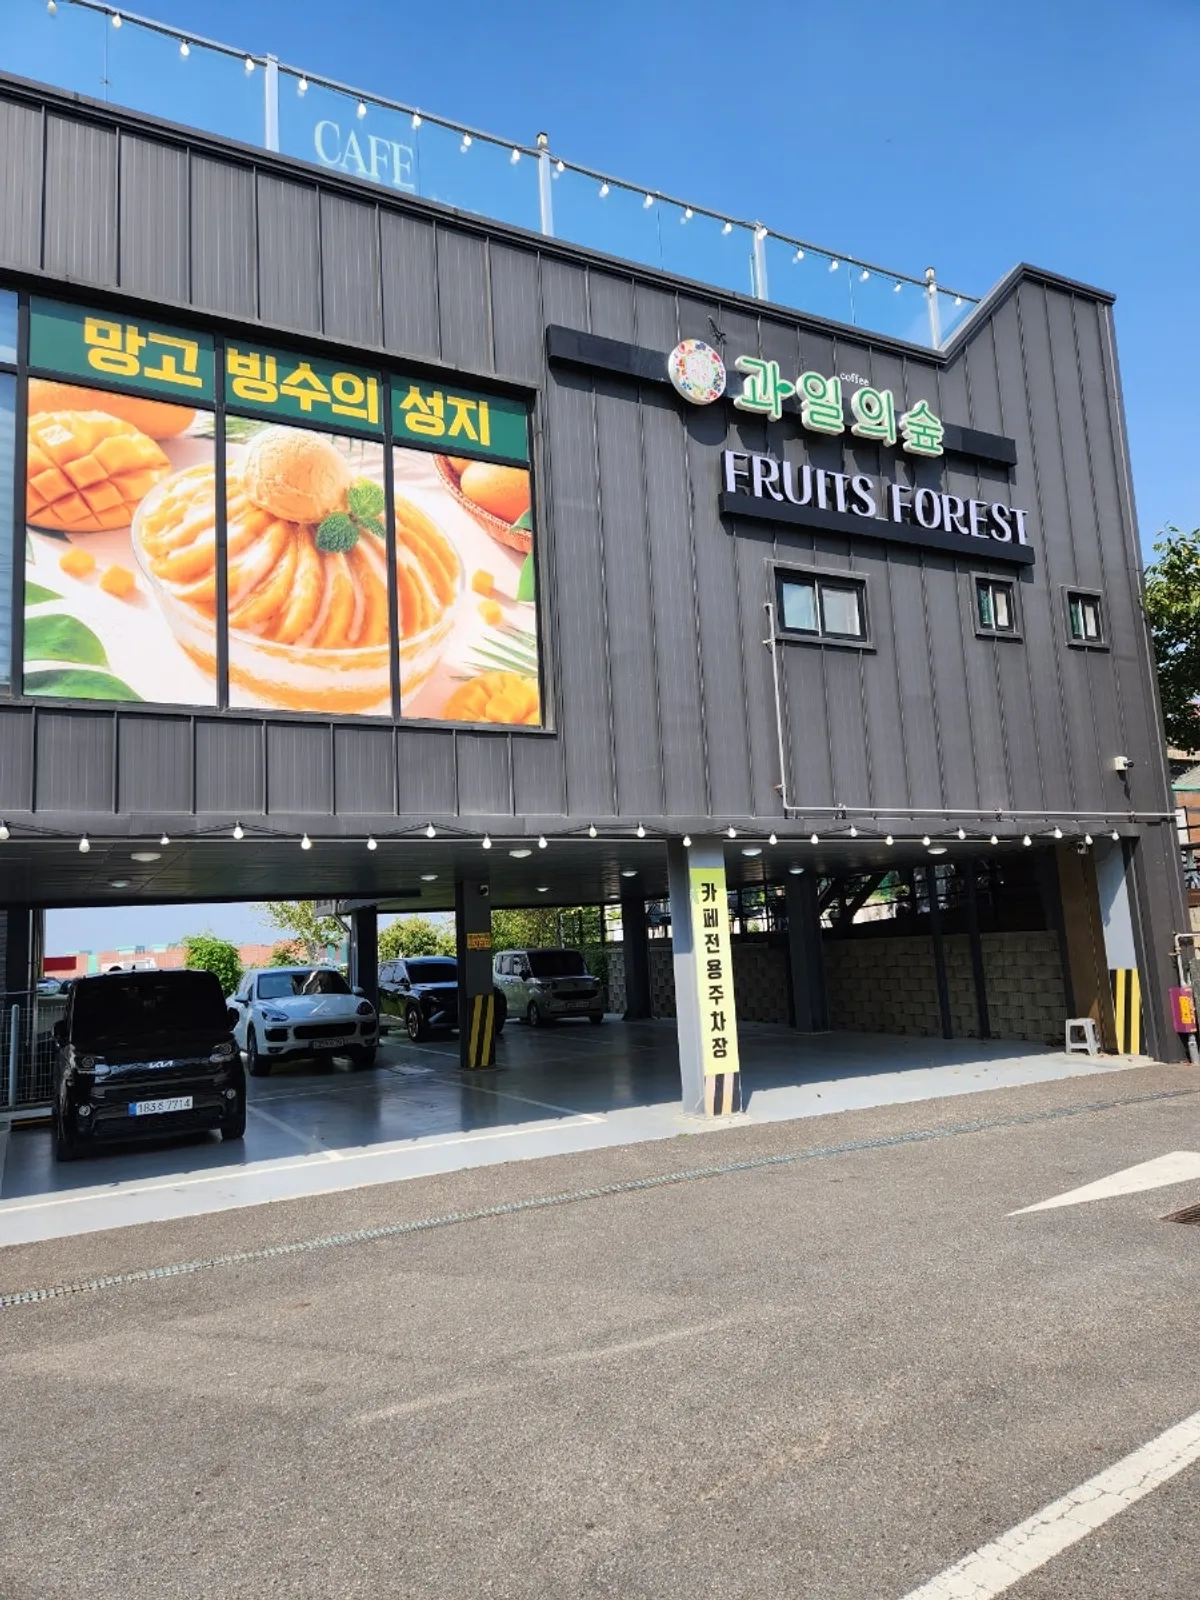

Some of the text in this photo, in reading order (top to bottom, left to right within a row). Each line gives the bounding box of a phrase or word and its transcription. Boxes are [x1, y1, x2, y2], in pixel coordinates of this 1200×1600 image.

[314, 120, 415, 188] CAFE
[84, 317, 490, 446] 망고 빙수의 성지
[840, 372, 869, 386] coffee
[724, 450, 1029, 545] FRUITS FOREST
